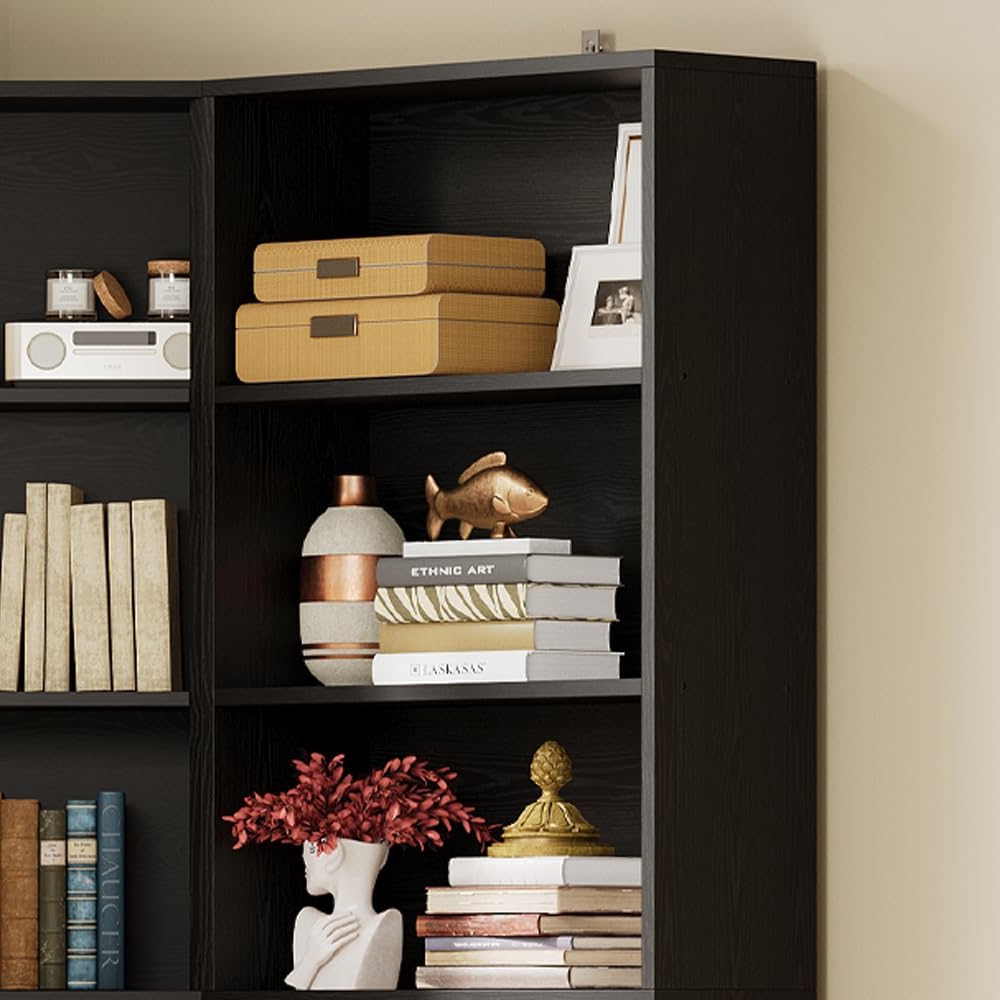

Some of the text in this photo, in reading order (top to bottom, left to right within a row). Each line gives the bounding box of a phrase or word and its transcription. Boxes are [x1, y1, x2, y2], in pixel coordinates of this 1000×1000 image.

[411, 564, 496, 577] ETHNIC ART
[422, 663, 485, 676] LASKASAS
[101, 804, 121, 968] CHAUCER
